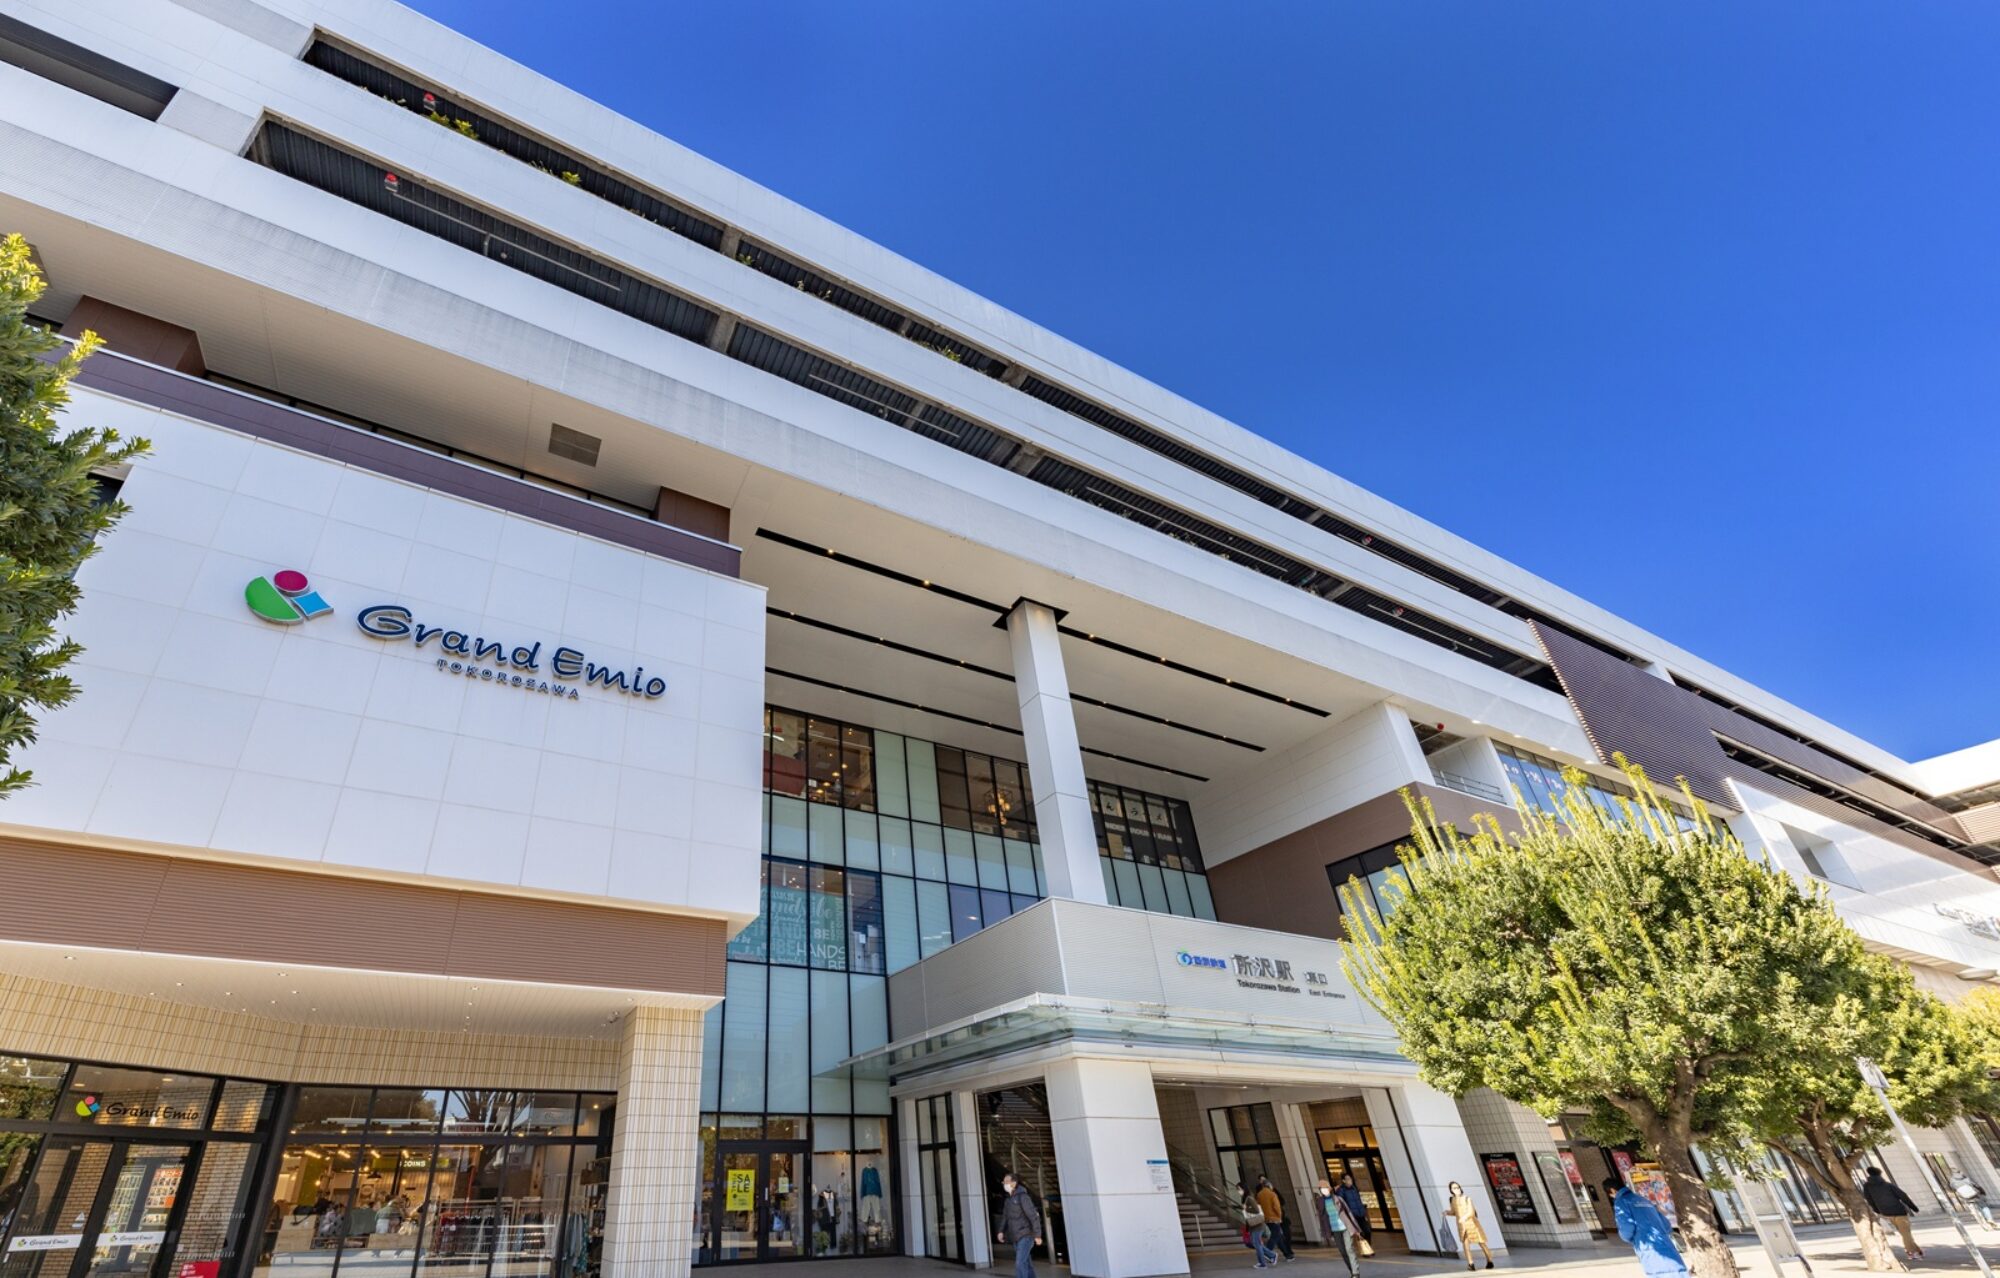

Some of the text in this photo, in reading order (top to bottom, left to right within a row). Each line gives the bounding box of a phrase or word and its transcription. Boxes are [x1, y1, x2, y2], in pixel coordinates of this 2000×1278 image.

[356, 605, 667, 699] Grand Emio
[436, 658, 580, 699] TOKOROZAWA
[1232, 953, 1295, 981] 所沢駅
[1237, 979, 1301, 994] Tokorozawa Station
[106, 1102, 199, 1120] Grand Emio
